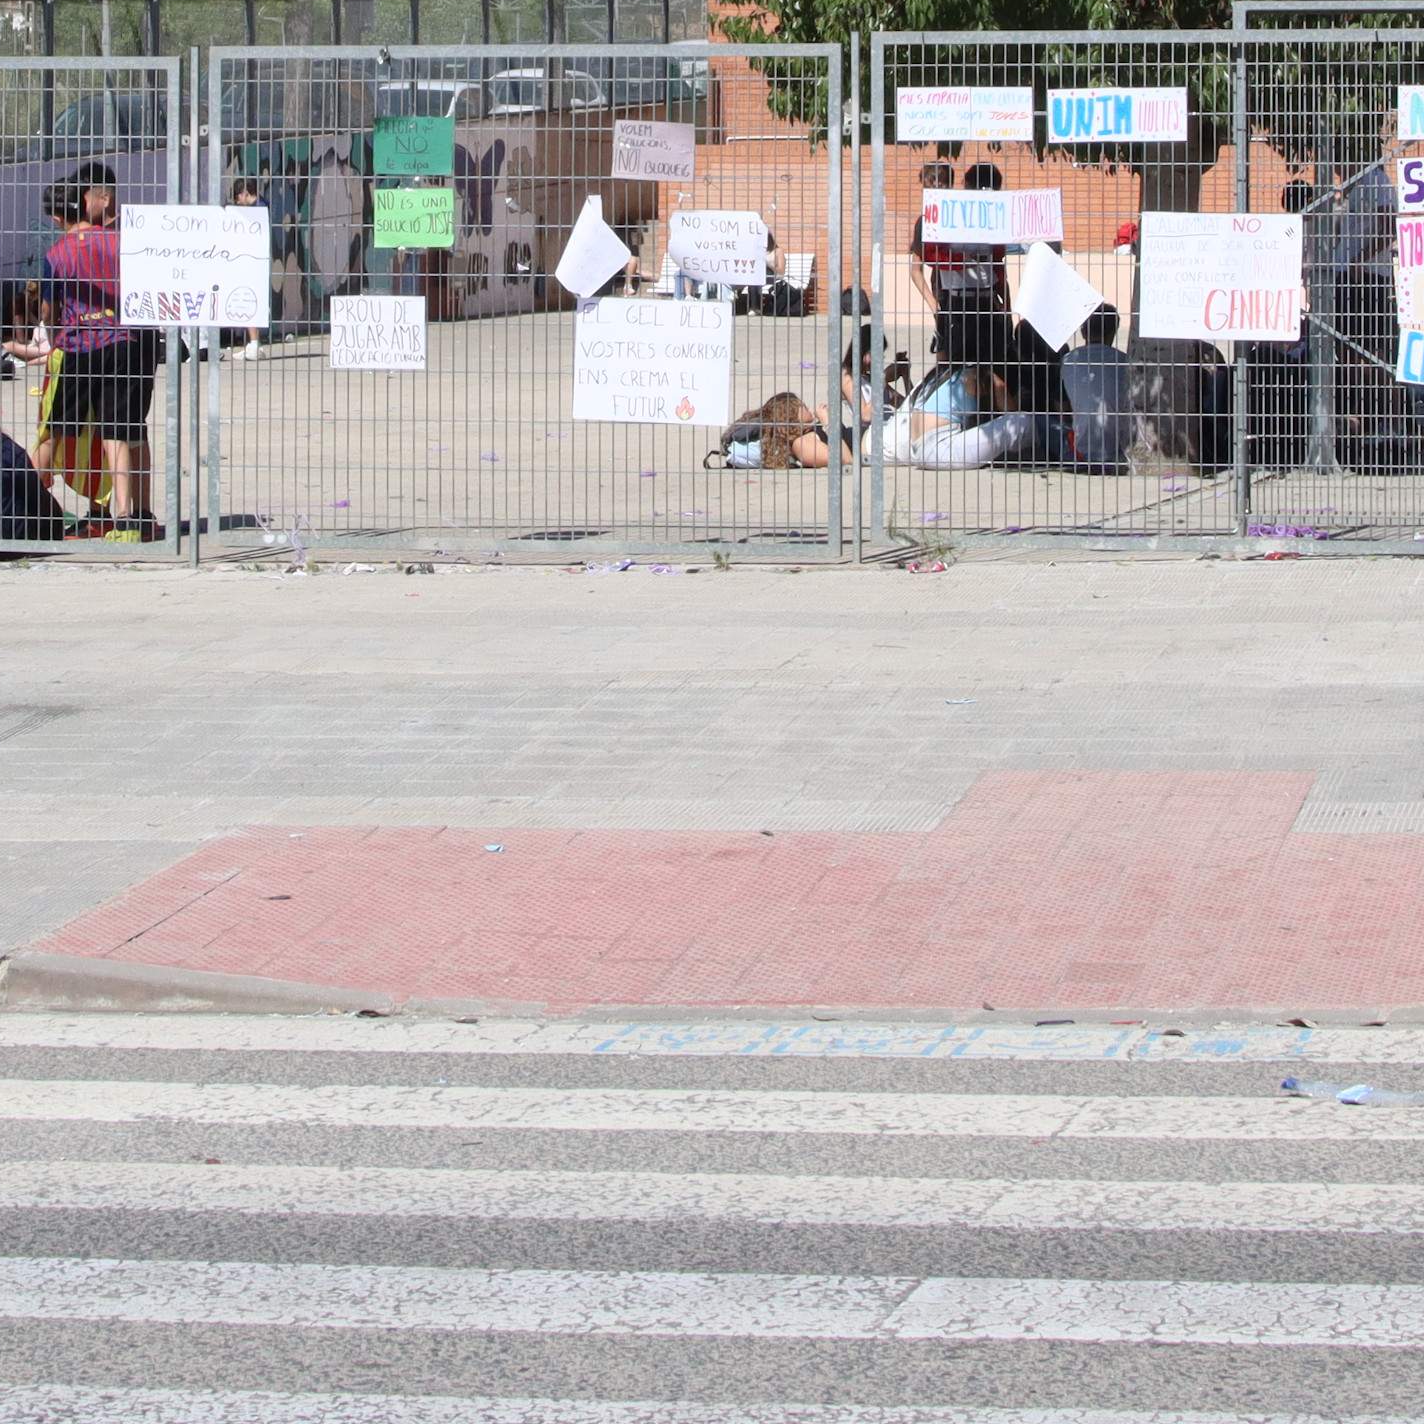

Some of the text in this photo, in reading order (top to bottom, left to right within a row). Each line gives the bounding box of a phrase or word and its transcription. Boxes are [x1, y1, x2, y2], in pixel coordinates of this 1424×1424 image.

[1052, 94, 1132, 138] UNIM
[620, 123, 653, 137] VOLEM
[395, 135, 429, 154] NO
[618, 149, 638, 173] NO
[376, 191, 395, 211] NO
[422, 196, 448, 209] UNA
[924, 203, 938, 224] NO
[681, 215, 763, 236] NO SOM EL
[1232, 217, 1263, 234] NO
[134, 244, 240, 262] moneda
[694, 240, 737, 251] VOSTRE
[1252, 239, 1281, 251] QUI
[172, 267, 189, 280] DE
[1175, 272, 1237, 284] CONFLICTE
[333, 298, 382, 324] PROU
[625, 303, 665, 326] GEL
[679, 303, 723, 329] DELS
[332, 324, 422, 353] JUGAR AMB
[580, 340, 656, 359] VOSTRES
[578, 367, 700, 391] ENS CREMA EL
[612, 394, 669, 419] FUTUR
